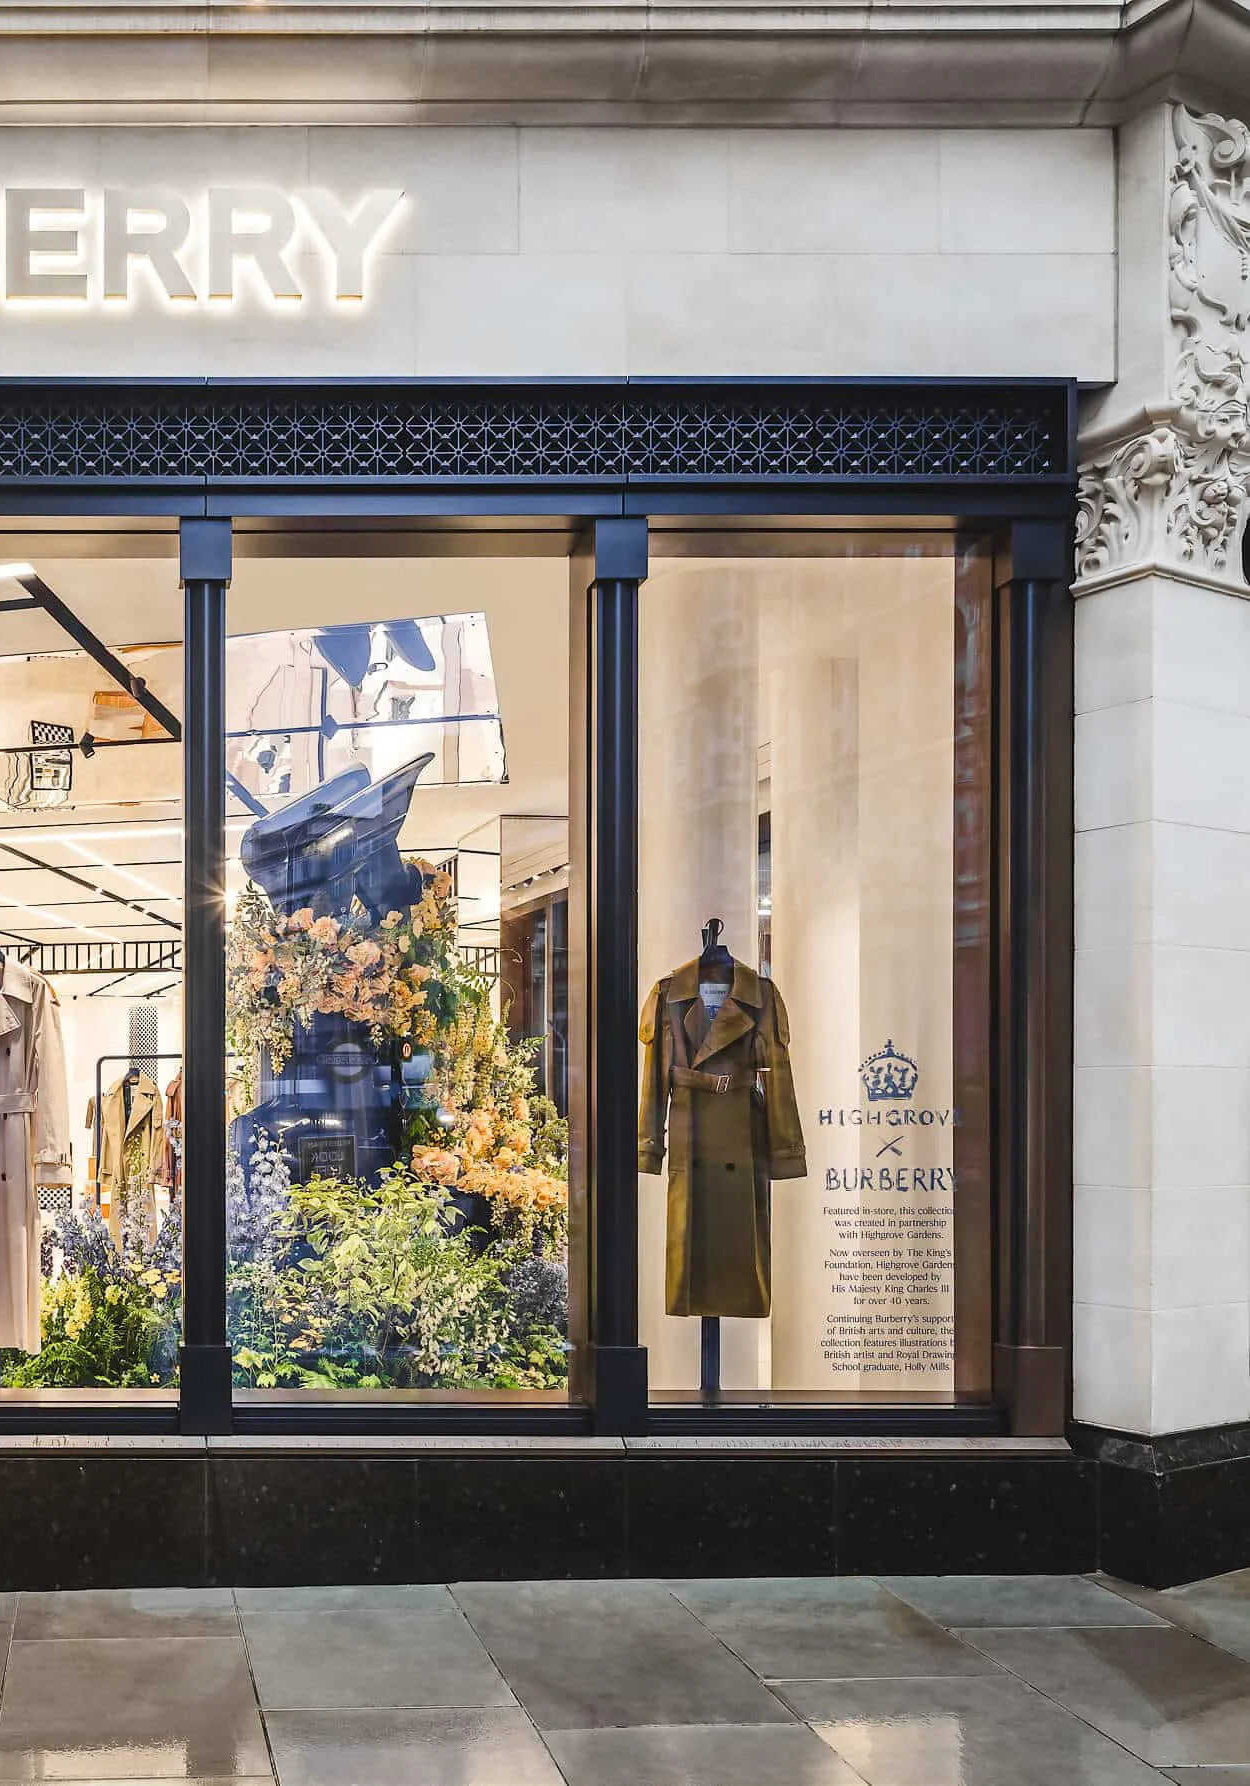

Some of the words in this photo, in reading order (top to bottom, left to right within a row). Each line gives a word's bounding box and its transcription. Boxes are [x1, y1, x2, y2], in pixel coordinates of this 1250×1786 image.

[823, 1207, 859, 1215] Featured
[863, 1207, 897, 1216] in-store,
[900, 1207, 914, 1215] this
[918, 1207, 956, 1215] collectio
[855, 1219, 885, 1227] created
[888, 1219, 896, 1227] in
[899, 1219, 947, 1229] partnership
[839, 1231, 858, 1239] with
[861, 1231, 904, 1241] Highgrove
[907, 1231, 944, 1239] Gardens.
[830, 1249, 849, 1257] Now
[893, 1249, 904, 1259] by
[907, 1248, 924, 1257] The
[824, 1261, 873, 1270] Foundation,
[876, 1261, 920, 1271] Highgrove
[840, 1273, 859, 1281] have
[863, 1273, 882, 1281] been
[886, 1273, 928, 1283] developed
[931, 1273, 941, 1283] by
[832, 1285, 845, 1293] His
[849, 1285, 881, 1294] Majesty
[884, 1285, 904, 1294] King
[907, 1285, 938, 1293] Charles
[854, 1296, 865, 1304] for
[905, 1298, 930, 1307] years.
[827, 1314, 873, 1324] Continuing
[827, 1326, 837, 1335] of
[839, 1326, 866, 1335] British
[888, 1327, 903, 1335] and
[906, 1327, 938, 1336] culture,
[821, 1338, 861, 1347] collection
[864, 1338, 897, 1347] features
[900, 1338, 947, 1347] illustrations
[824, 1350, 851, 1359] British
[854, 1351, 874, 1359] artist
[878, 1350, 894, 1359] and
[896, 1350, 919, 1361] Royal
[832, 1362, 860, 1371] School
[863, 1363, 901, 1373] graduate,
[905, 1363, 926, 1373] Holly
